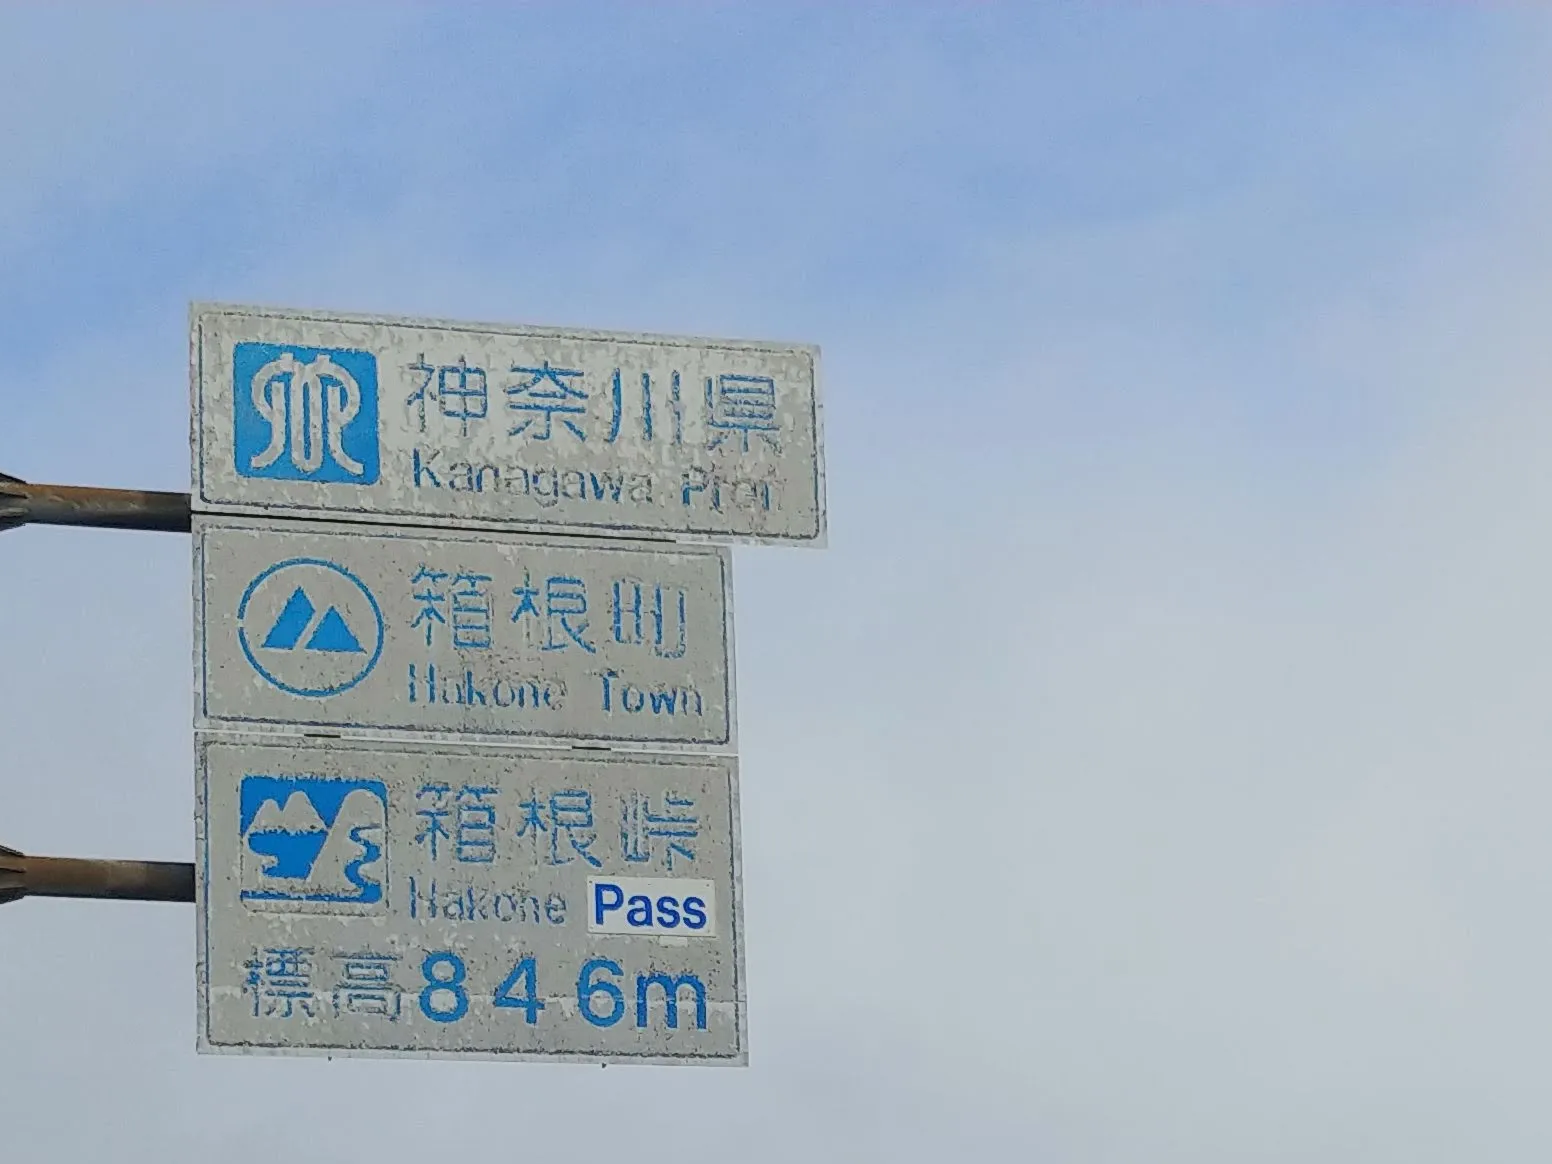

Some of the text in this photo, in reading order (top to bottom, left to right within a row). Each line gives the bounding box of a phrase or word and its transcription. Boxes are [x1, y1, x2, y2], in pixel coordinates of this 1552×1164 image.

[406, 351, 783, 455] 神奈川県
[413, 448, 653, 508] Kanagawa
[411, 562, 686, 659] 箱根町
[409, 662, 703, 717] Hakone Town
[415, 783, 698, 870] 箱根峠
[409, 875, 708, 930] Hakone Pass
